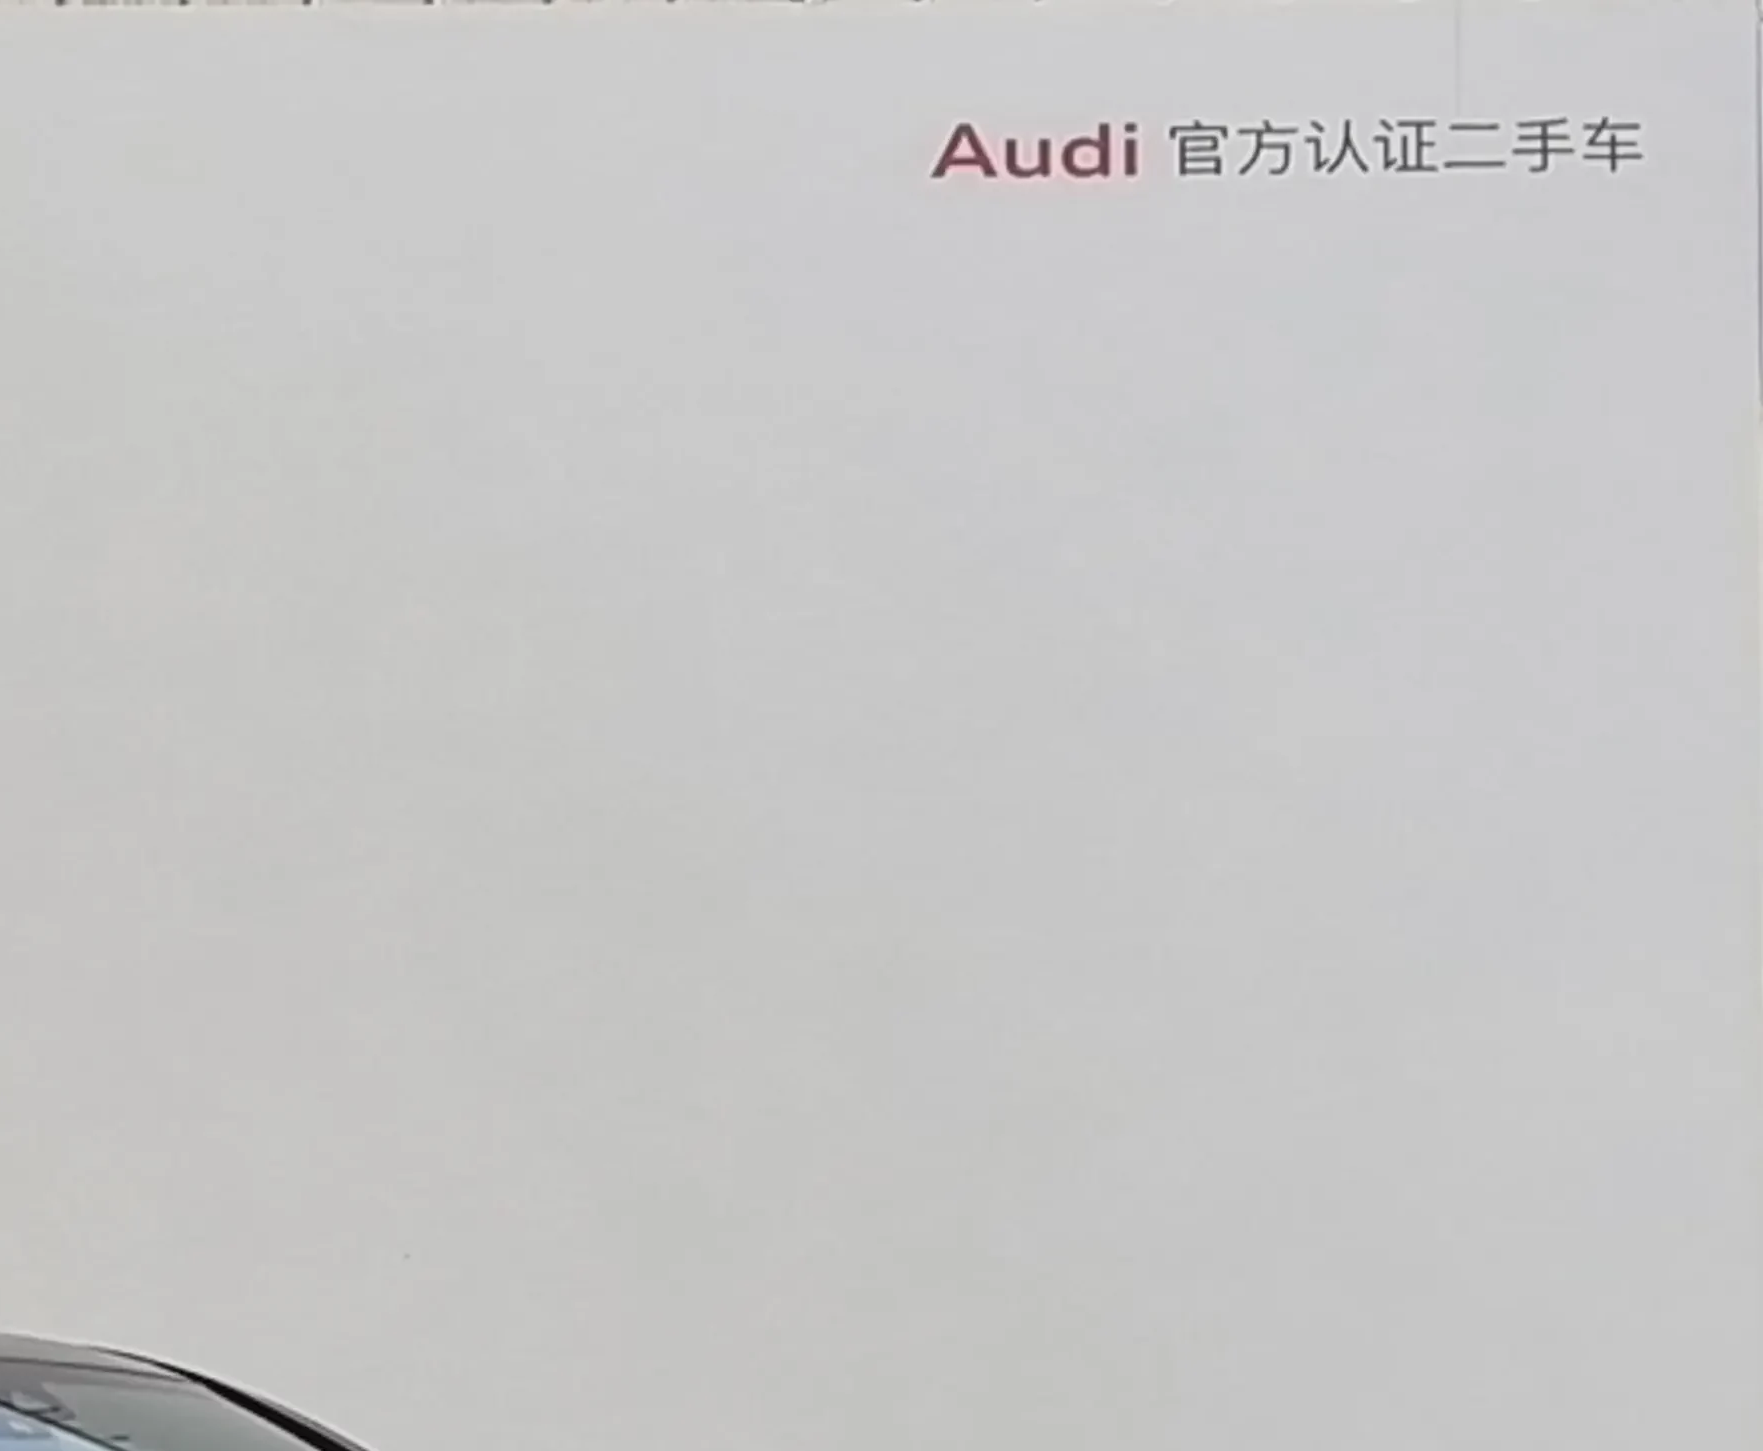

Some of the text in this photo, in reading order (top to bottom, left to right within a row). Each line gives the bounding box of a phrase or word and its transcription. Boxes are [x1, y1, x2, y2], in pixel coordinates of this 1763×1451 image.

[931, 117, 1644, 178] Audi 官方认证二手车
